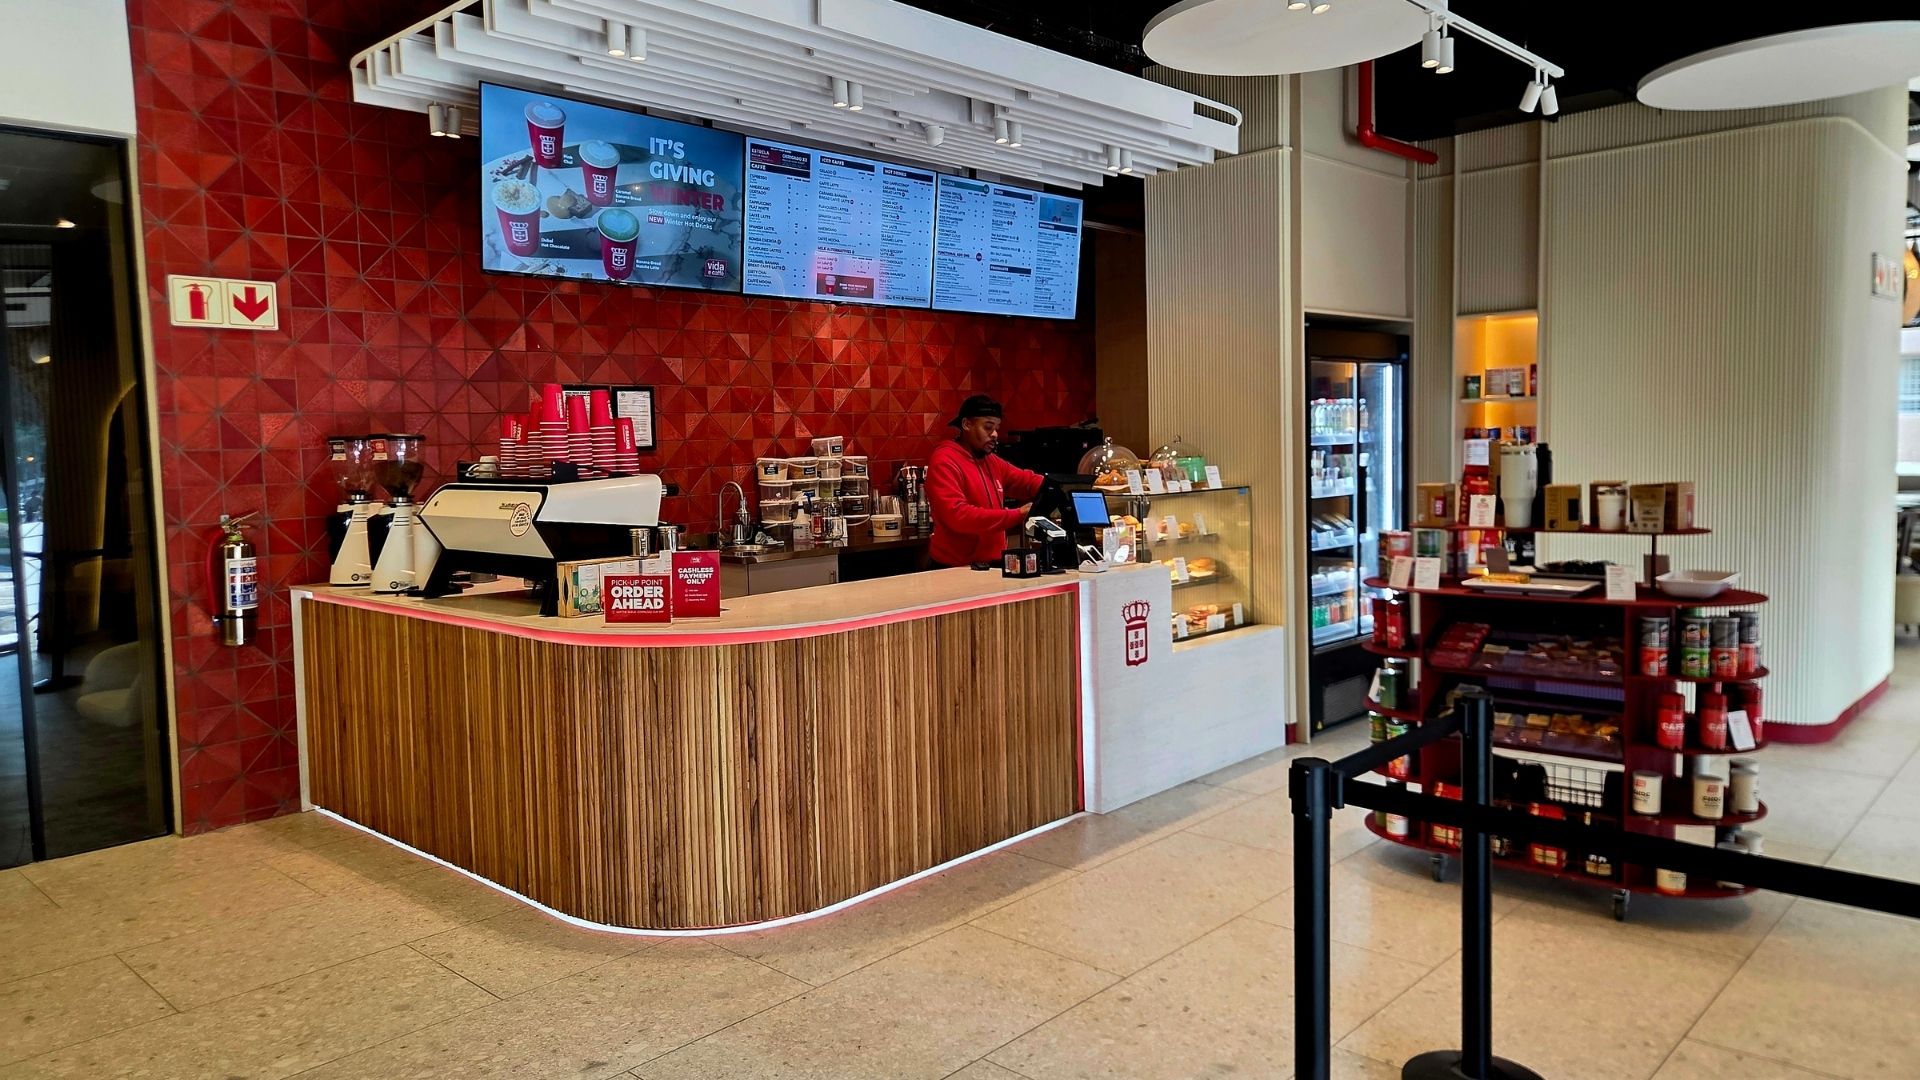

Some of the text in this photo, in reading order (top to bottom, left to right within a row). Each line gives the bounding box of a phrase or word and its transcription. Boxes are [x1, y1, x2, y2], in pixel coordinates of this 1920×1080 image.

[650, 137, 685, 159] IT'S
[649, 161, 715, 187] GIVING
[649, 184, 725, 211] WINTER
[648, 208, 663, 216] Slow
[664, 210, 680, 218] down
[648, 216, 664, 224] NEW
[708, 261, 724, 270] vida
[611, 586, 664, 598] ORDER
[612, 598, 664, 609] AHEAD
